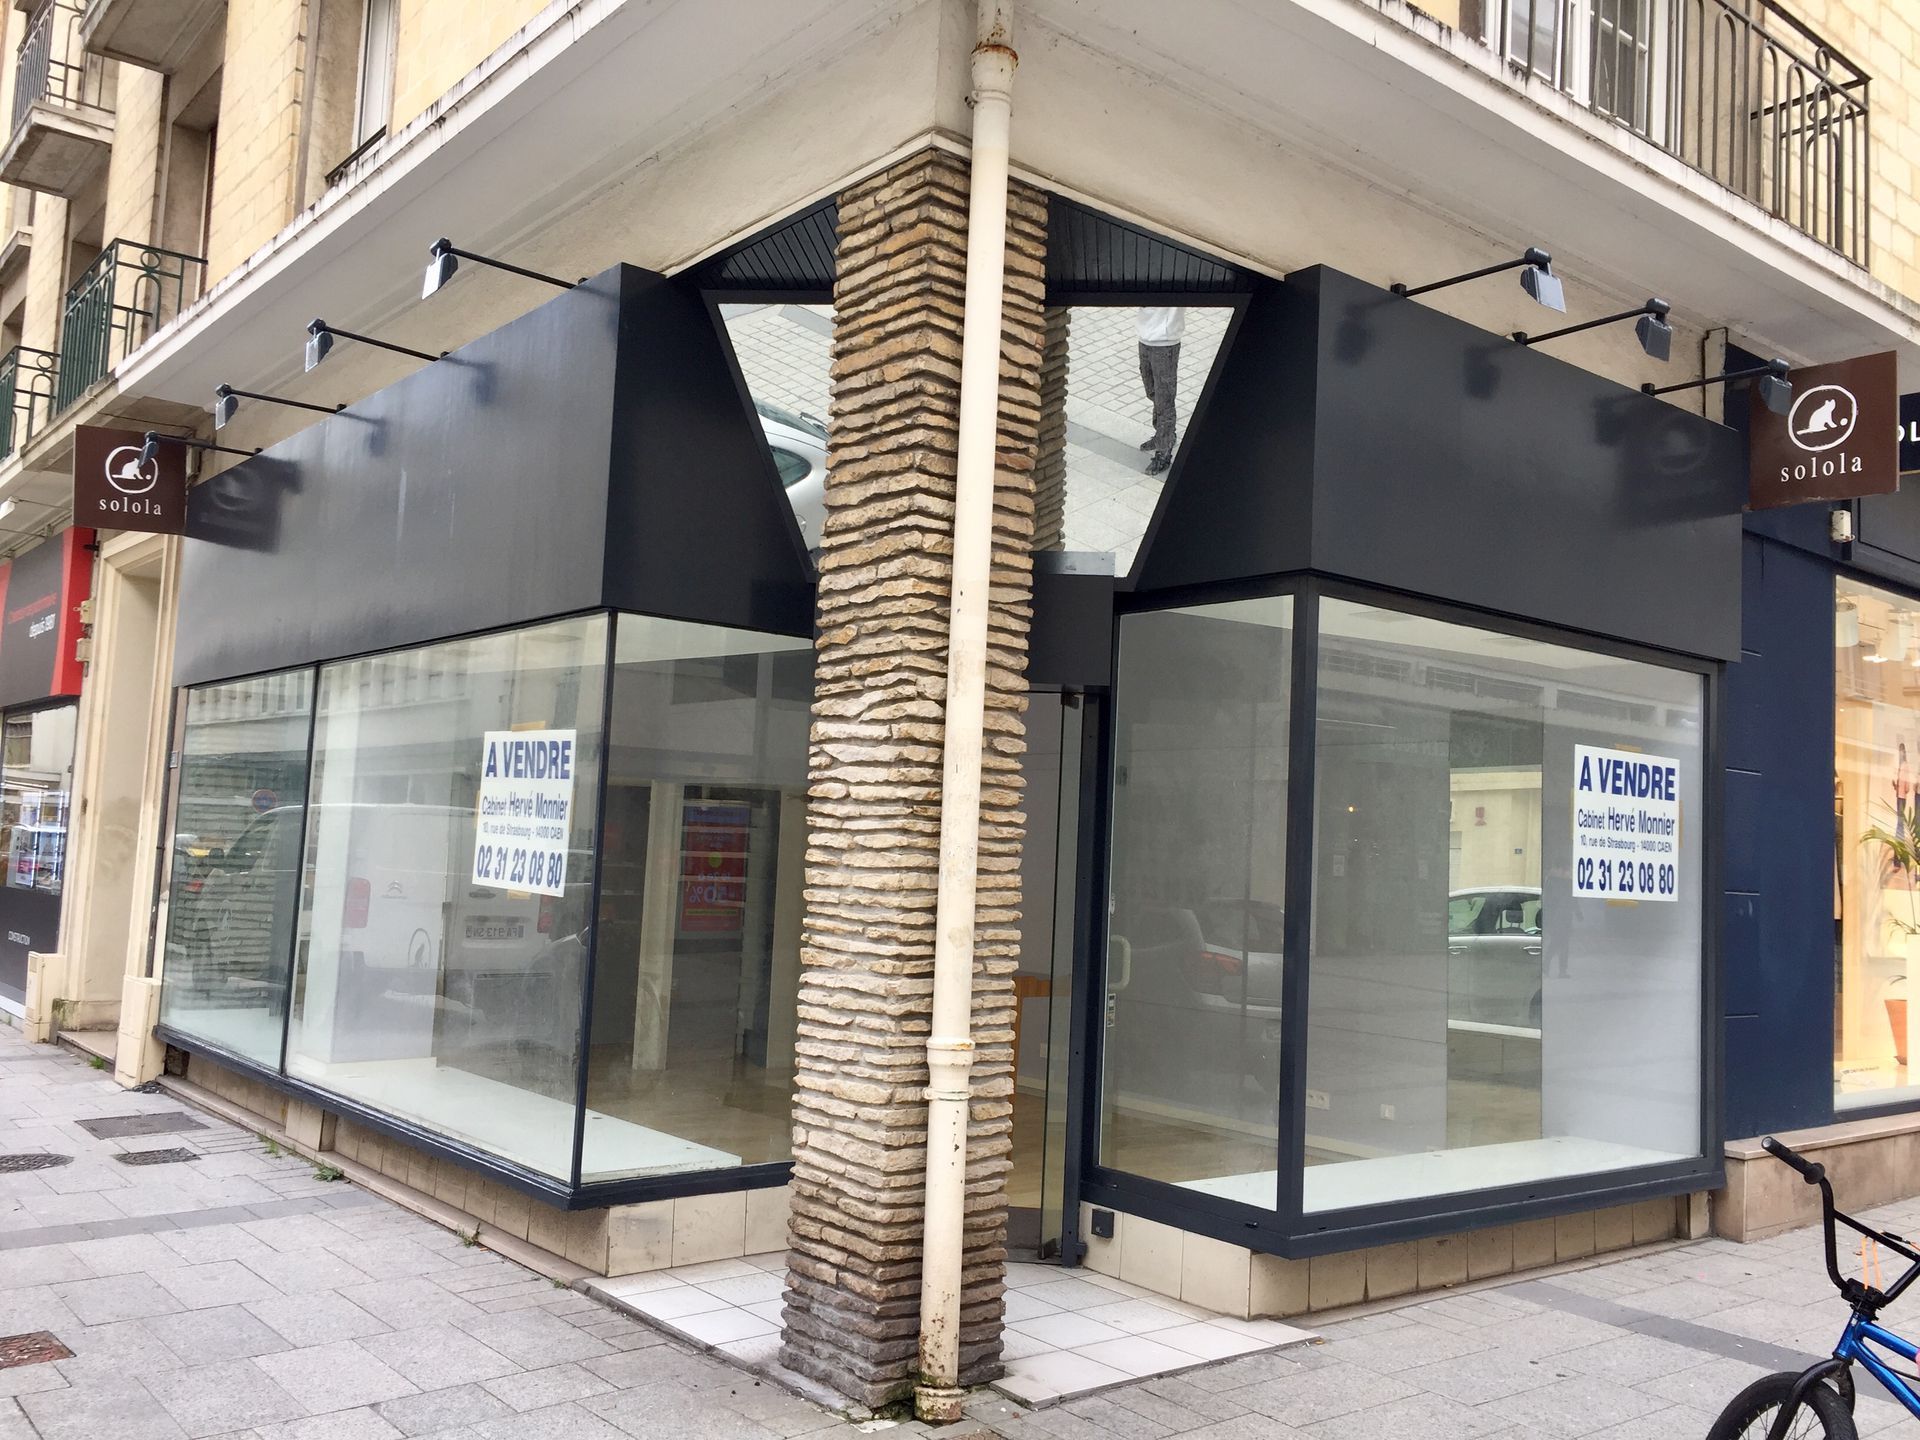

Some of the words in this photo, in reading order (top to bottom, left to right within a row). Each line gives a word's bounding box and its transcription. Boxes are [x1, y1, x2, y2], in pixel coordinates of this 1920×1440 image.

[1781, 452, 1863, 482] solola
[99, 497, 162, 515] solola
[485, 741, 497, 778] A
[503, 740, 572, 779] VENDRE
[1579, 756, 1592, 791] A
[1598, 757, 1676, 802] VENDRE
[482, 796, 507, 816] Cabinet
[509, 790, 533, 816] Hervé
[535, 792, 568, 820] Monnier
[500, 824, 506, 835] de
[506, 823, 532, 841] Strasbourg
[550, 826, 564, 840] CAEN
[1578, 808, 1605, 830] Cabinet
[1608, 806, 1635, 833] Hervé
[1638, 809, 1675, 836] Monnier
[1588, 838, 1598, 848] rue
[1598, 836, 1606, 847] de
[1607, 837, 1636, 853] Strasbourg
[1657, 841, 1672, 853] CAEN
[477, 844, 492, 878] 02
[494, 846, 509, 880] 31
[510, 848, 526, 883] 23
[528, 849, 545, 886] 08
[546, 852, 563, 889] 80
[1577, 857, 1594, 890] 02
[1598, 859, 1612, 891] 31
[1619, 860, 1634, 893] 23
[1639, 862, 1654, 894] 08
[1659, 863, 1674, 895] 80
